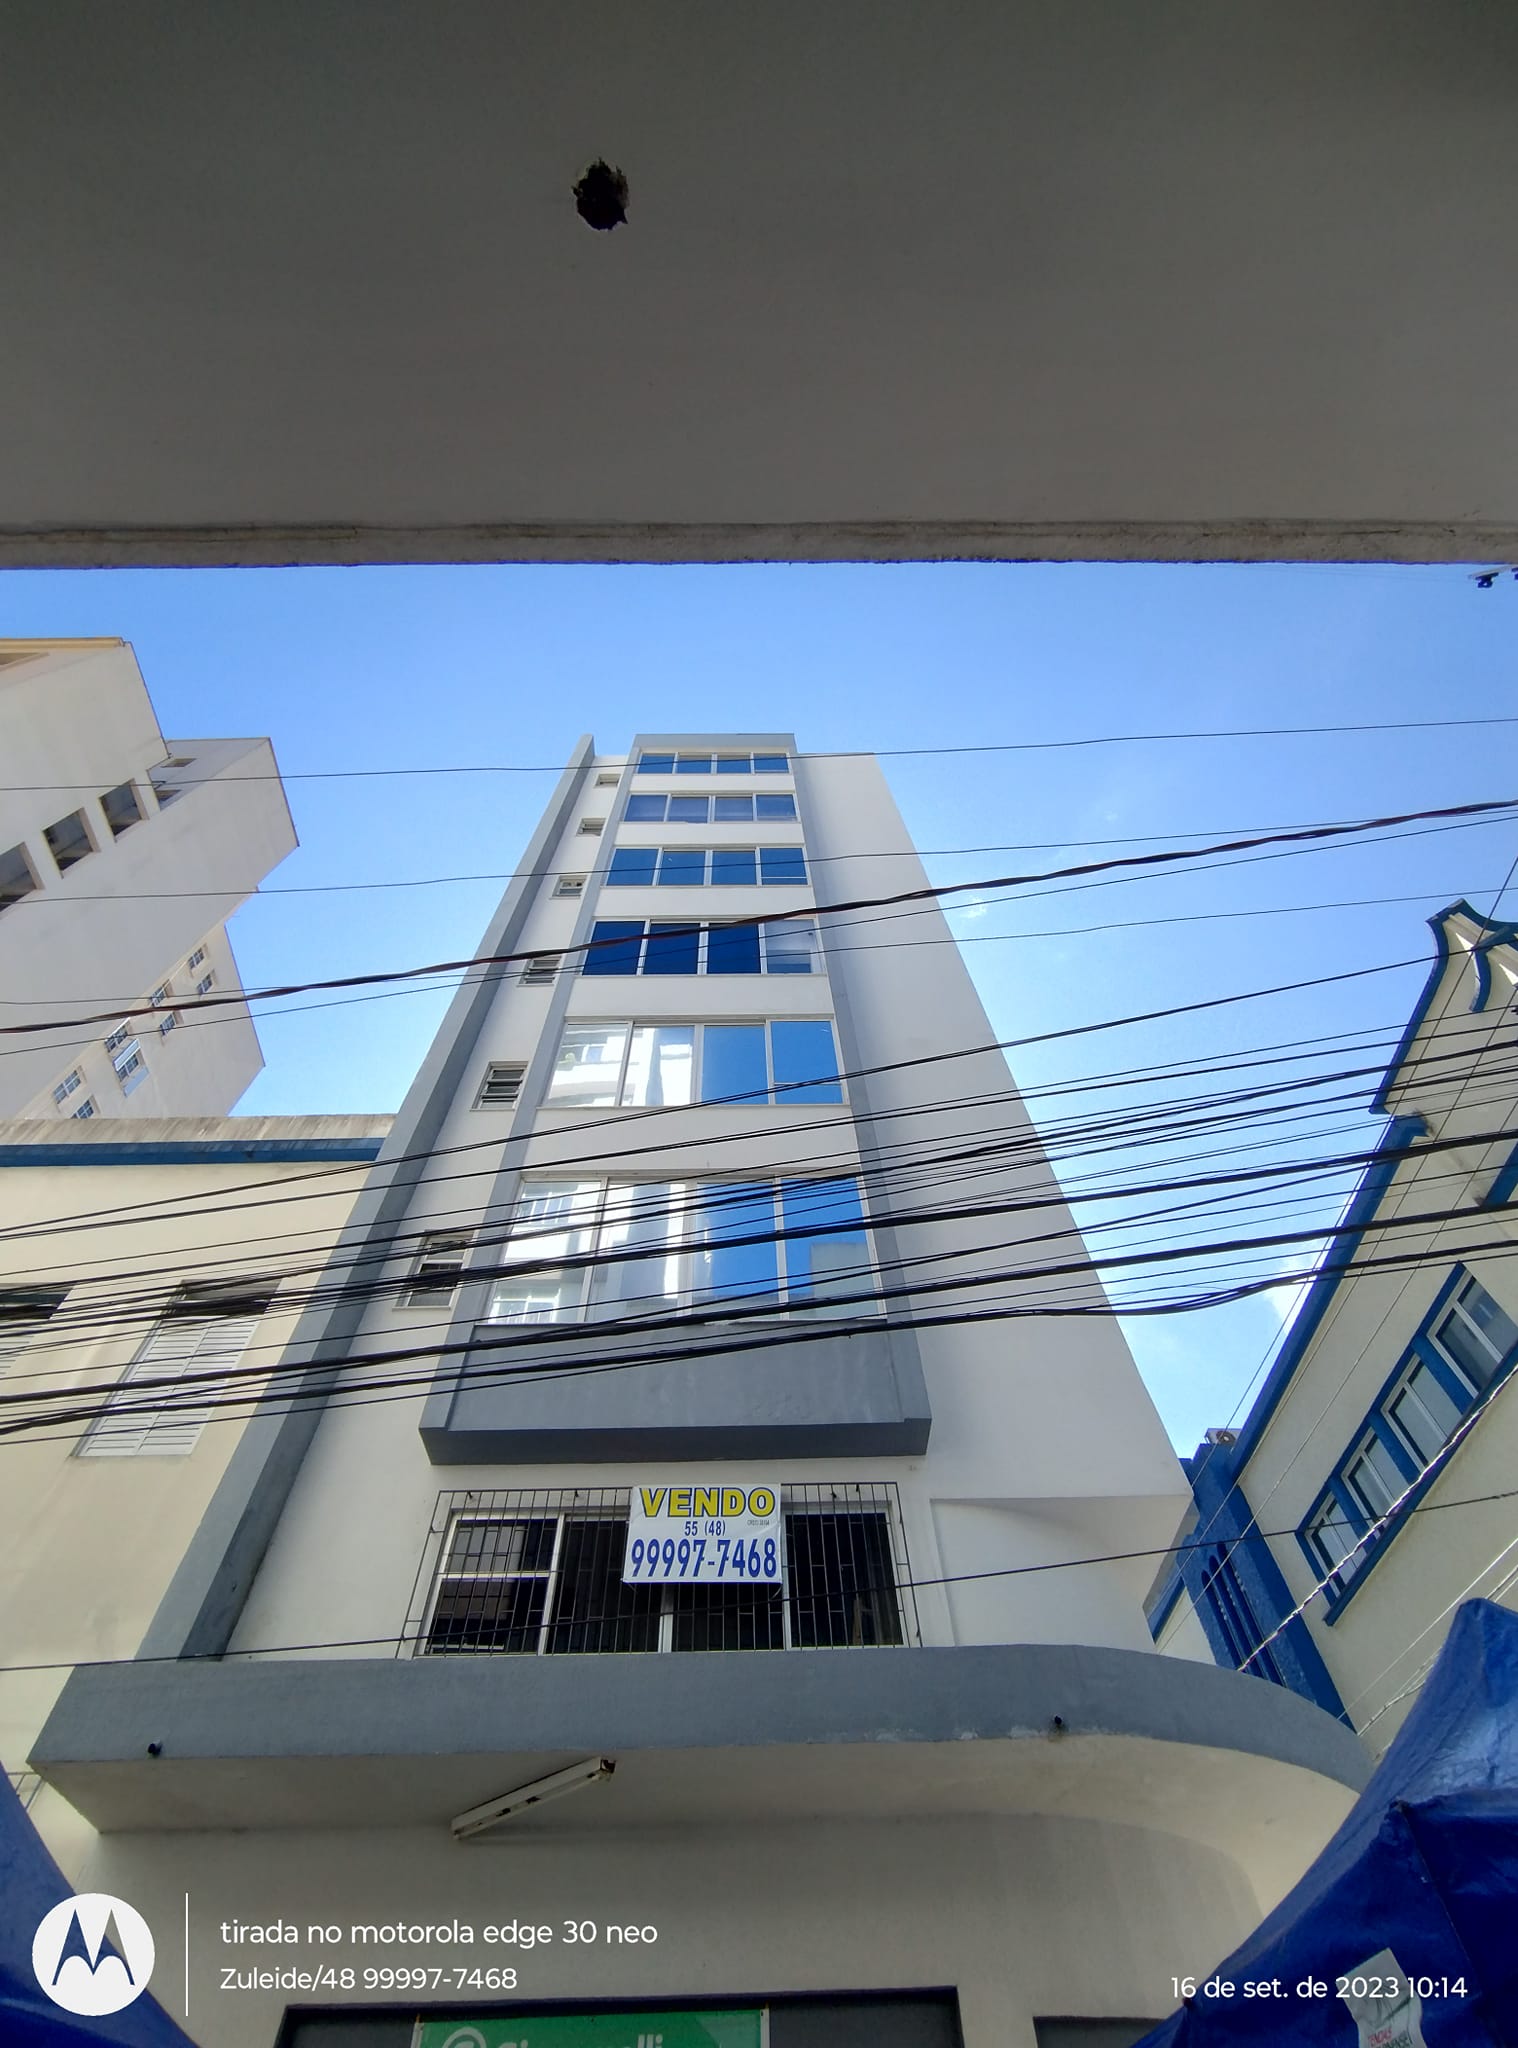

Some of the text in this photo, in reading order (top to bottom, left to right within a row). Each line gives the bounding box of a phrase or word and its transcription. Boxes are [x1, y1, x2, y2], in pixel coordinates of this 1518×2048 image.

[639, 1487, 775, 1518] VENDO
[684, 1520, 726, 1537] 55 (48)
[631, 1538, 777, 1578] 99997-7468
